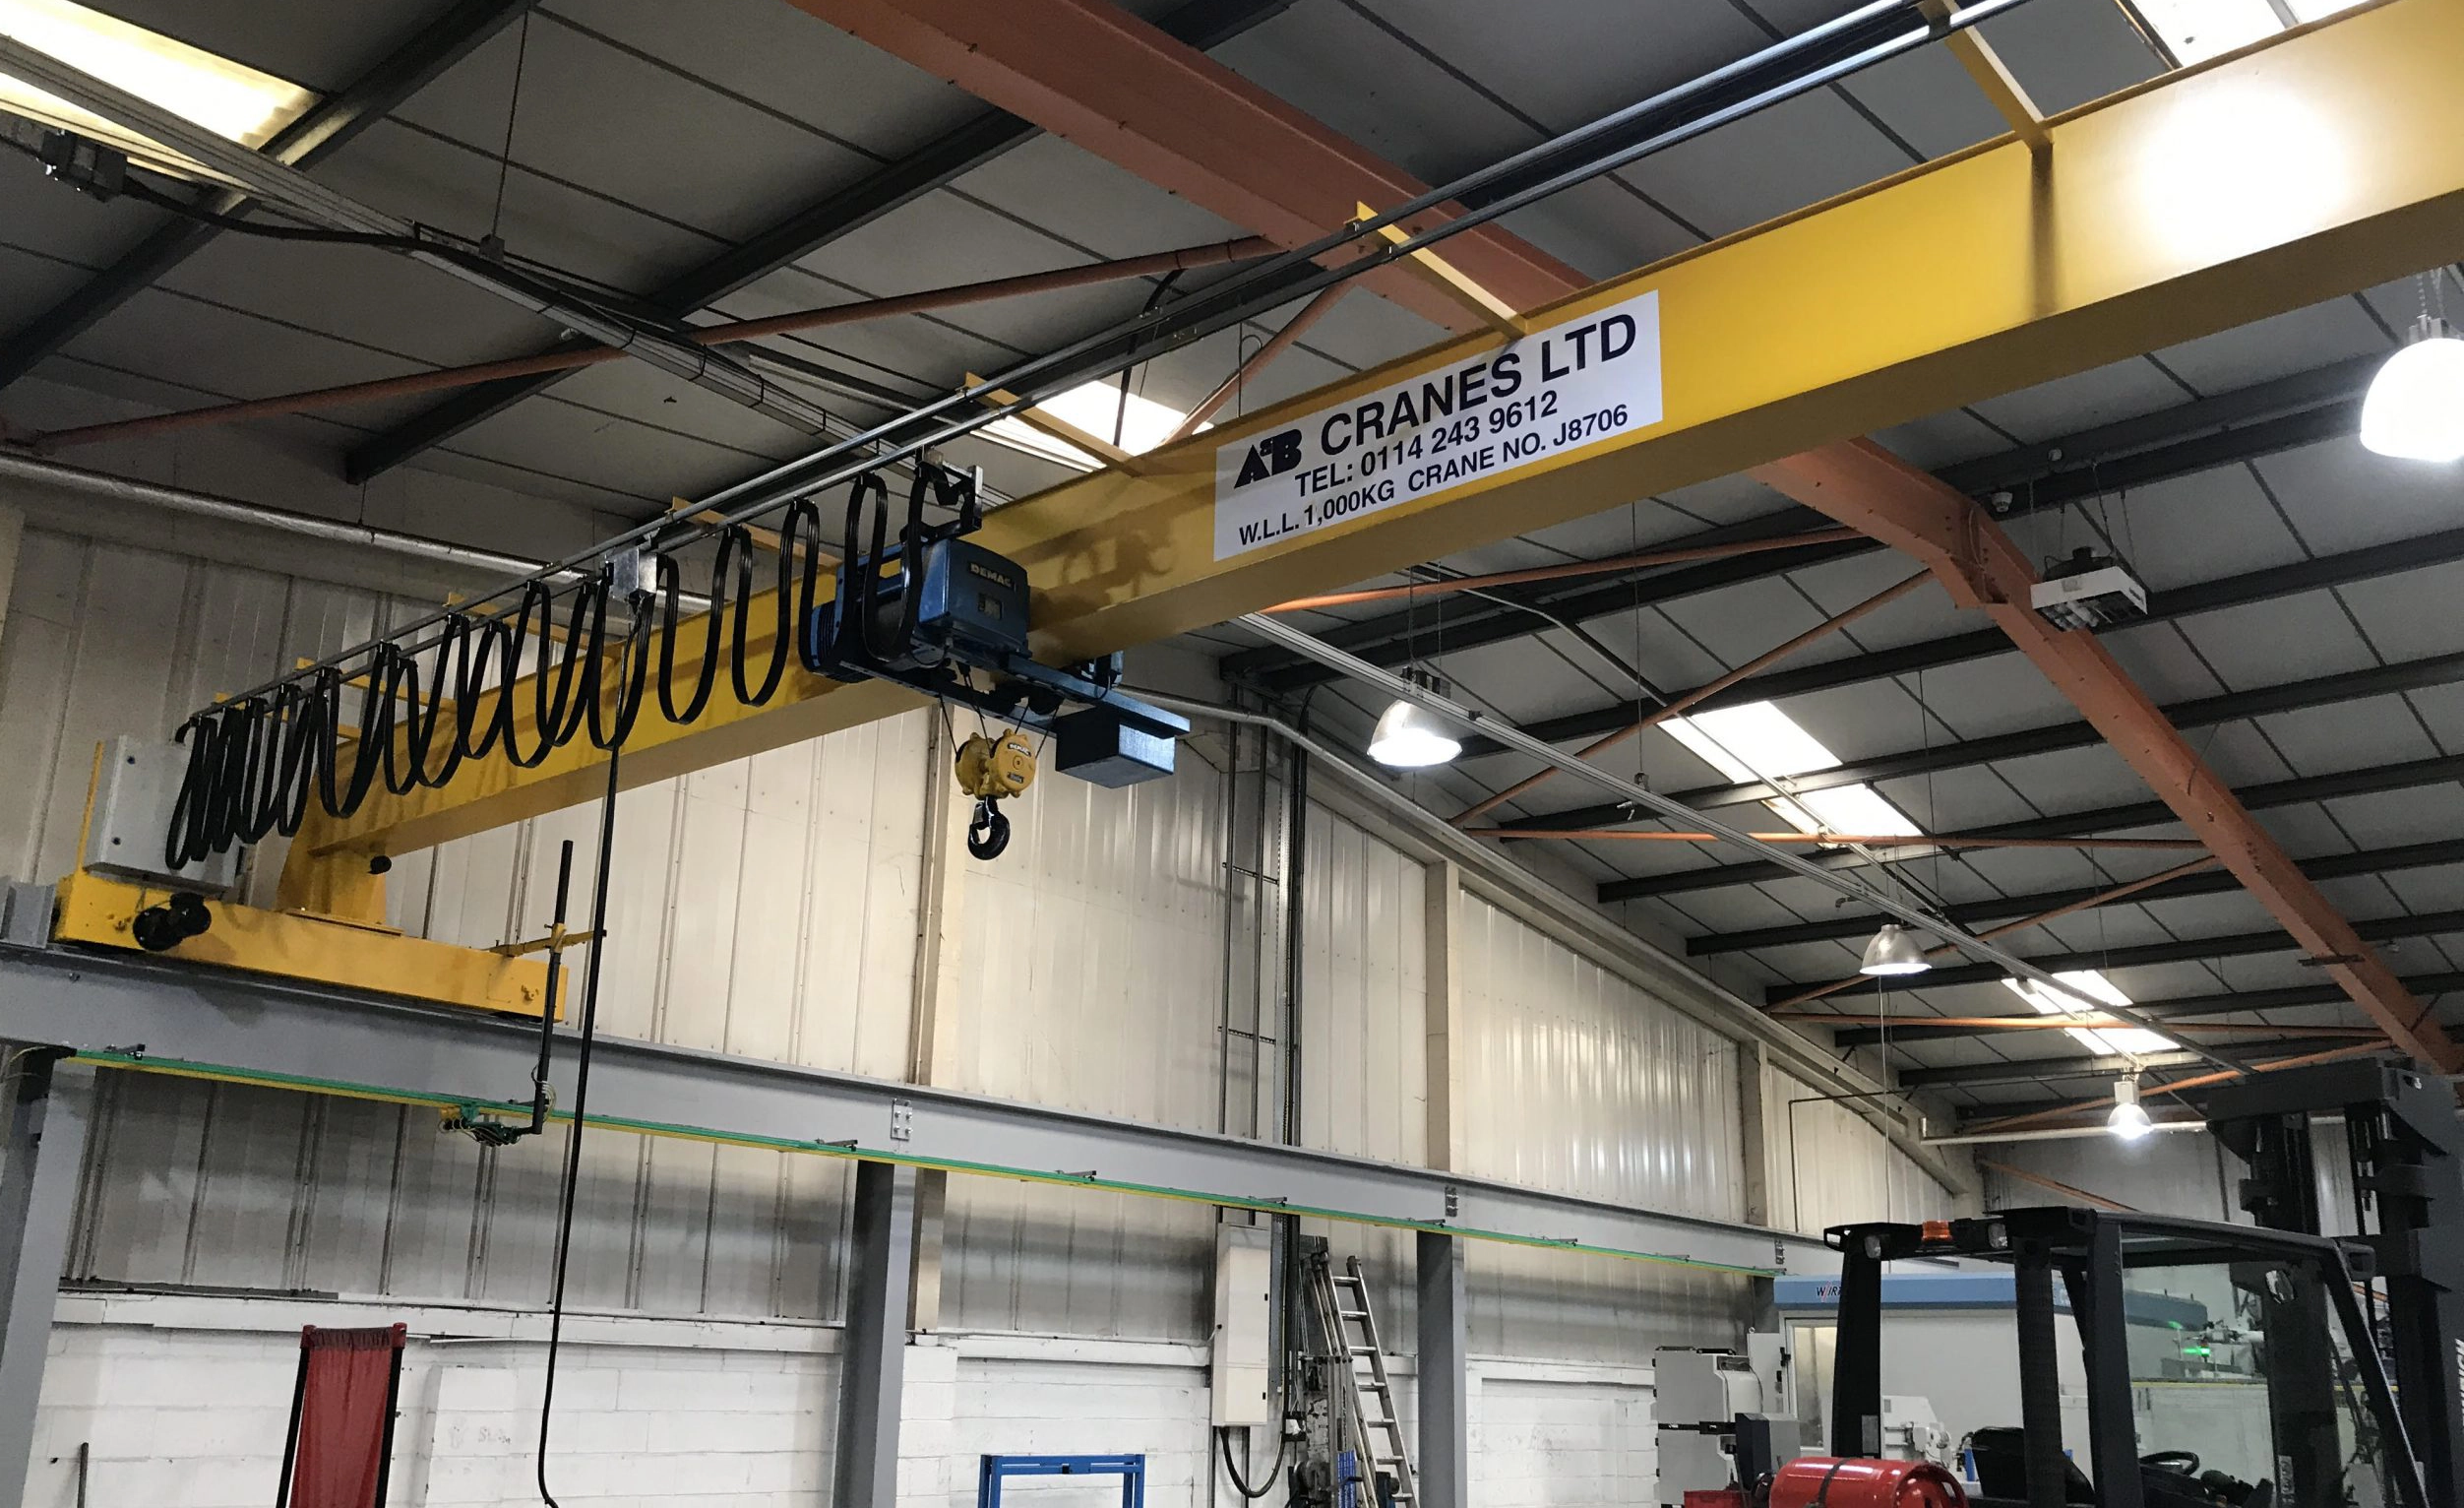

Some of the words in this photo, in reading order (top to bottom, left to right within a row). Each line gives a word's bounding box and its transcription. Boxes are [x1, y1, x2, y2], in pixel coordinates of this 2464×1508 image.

[1295, 465, 1353, 497] TEL:
[1361, 442, 1423, 477] 0114
[1432, 420, 1480, 456] 243
[1489, 390, 1558, 434] 9612
[1321, 353, 1521, 456] CRANES
[1541, 314, 1636, 382] LTD
[1239, 513, 1300, 545] W.L.L.
[1304, 479, 1395, 527] 1,000KG
[1408, 446, 1495, 492] CRANE
[1503, 432, 1547, 466] NO.
[1553, 404, 1629, 446] J8706
